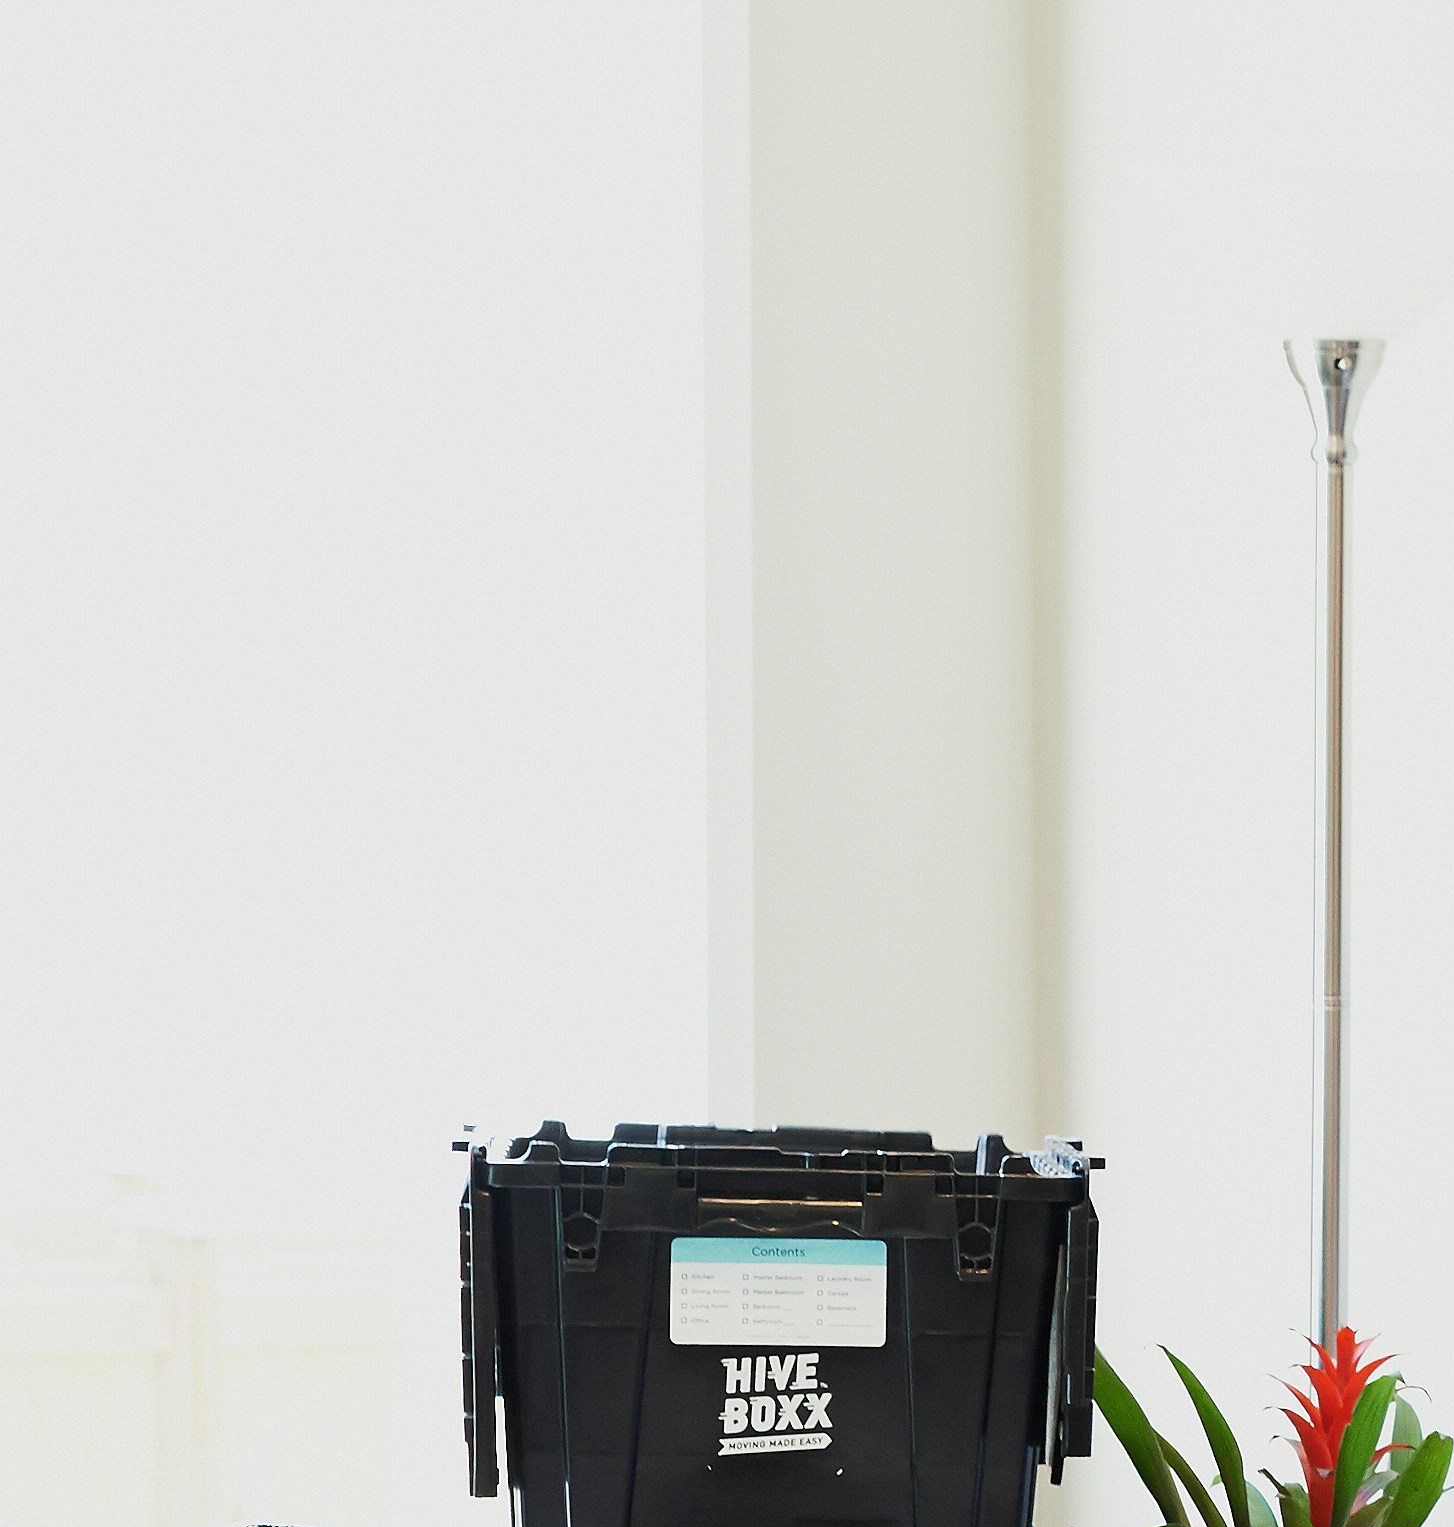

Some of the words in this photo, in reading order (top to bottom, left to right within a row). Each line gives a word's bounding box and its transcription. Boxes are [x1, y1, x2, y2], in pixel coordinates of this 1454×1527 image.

[752, 1247, 805, 1257] Contents
[720, 1352, 820, 1394] HIVE
[718, 1393, 834, 1435] BOXX
[728, 1440, 766, 1451] MOVING
[769, 1438, 796, 1449] MADE
[799, 1436, 824, 1446] EASY
